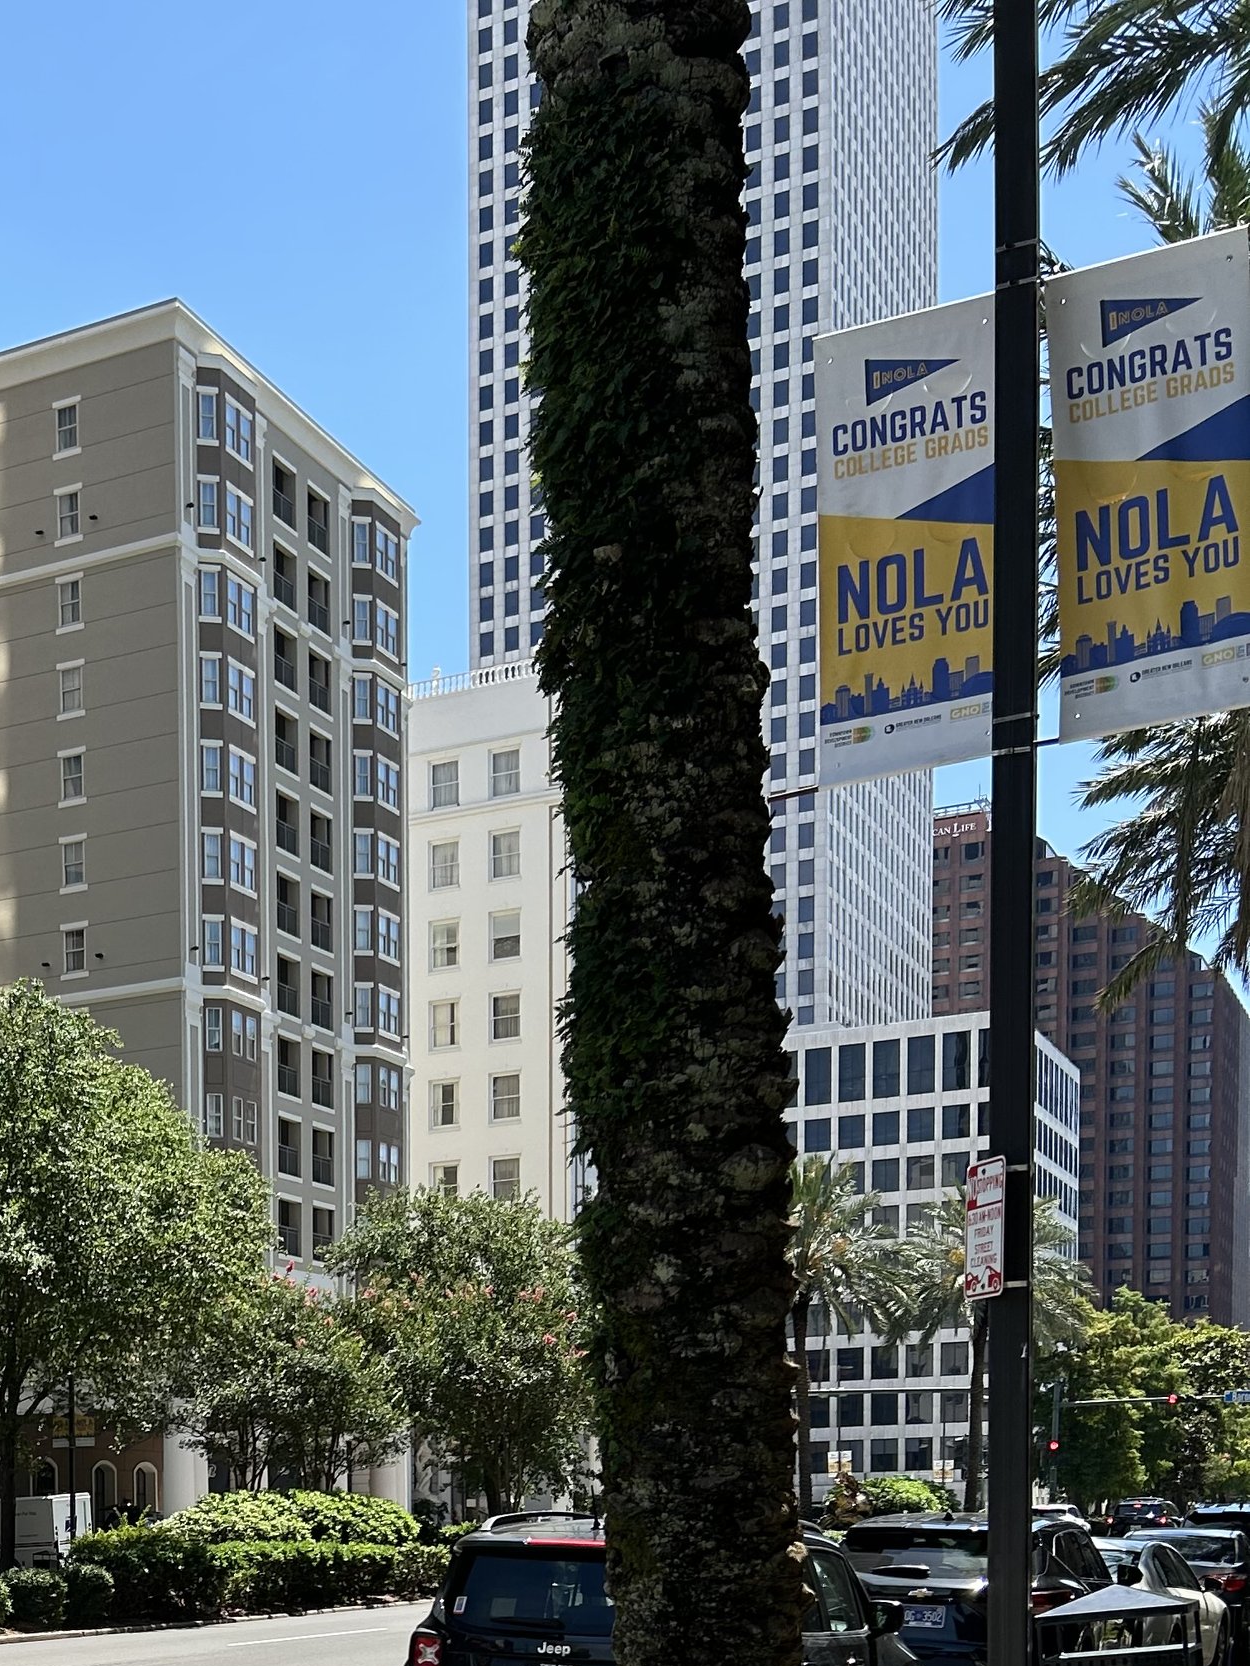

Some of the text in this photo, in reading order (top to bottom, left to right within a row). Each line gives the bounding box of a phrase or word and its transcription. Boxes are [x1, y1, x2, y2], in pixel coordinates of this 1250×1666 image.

[1066, 327, 1233, 400] CONGRATS
[1069, 361, 1235, 424] COLLEGE GRADS
[832, 390, 987, 457] CONGRATS
[833, 426, 989, 480] COLLEGE GRADS
[1075, 474, 1239, 573] NOLA
[837, 536, 989, 625] NOLA
[1077, 535, 1240, 605] LOVES YOU
[837, 598, 989, 657] LOVES YOU
[1203, 649, 1234, 665] GNO
[970, 1252, 998, 1268] CLEANING
[974, 1225, 994, 1240] FRIDAY
[974, 1241, 994, 1254] STREET
[537, 1641, 571, 1657] Jeep
